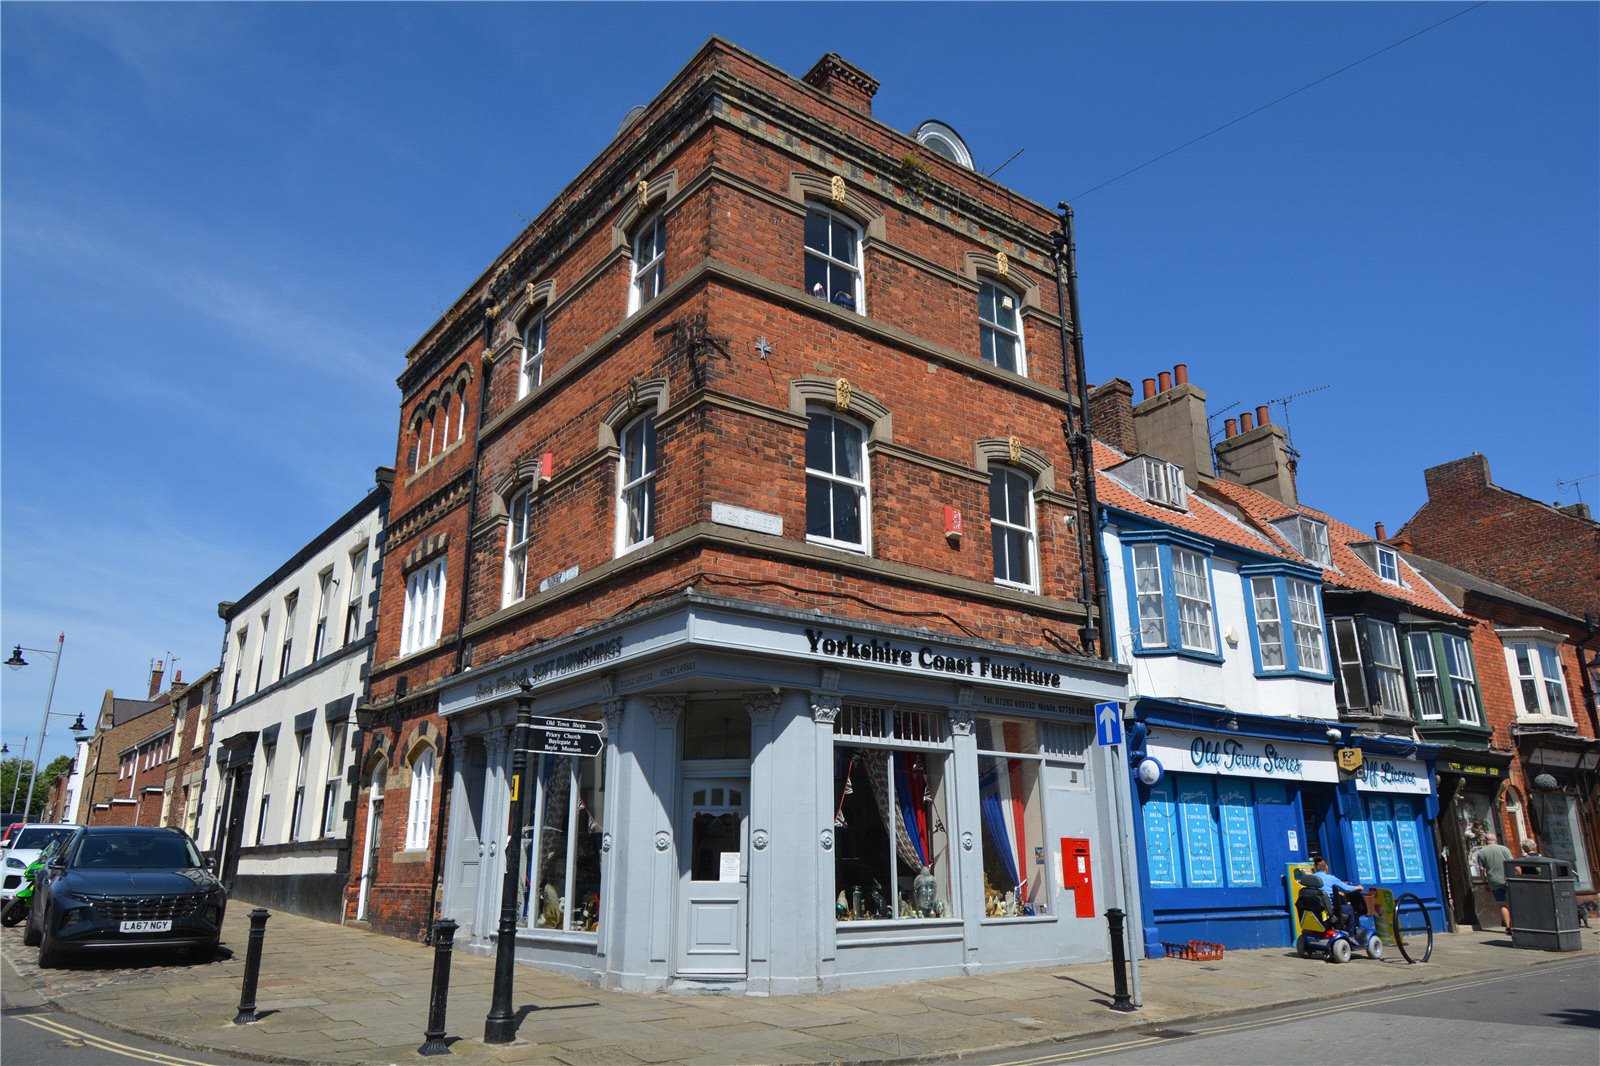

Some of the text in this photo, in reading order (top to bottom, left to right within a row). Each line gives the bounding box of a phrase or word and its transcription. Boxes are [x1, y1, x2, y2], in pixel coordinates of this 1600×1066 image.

[804, 630, 1061, 688] Yorkshire Coast Furniture
[572, 722, 586, 730] Shops
[545, 731, 561, 739] Priory
[1190, 736, 1302, 774] Old Town Stores
[1380, 762, 1417, 785] Licence
[124, 922, 168, 930] LA67 NGY
